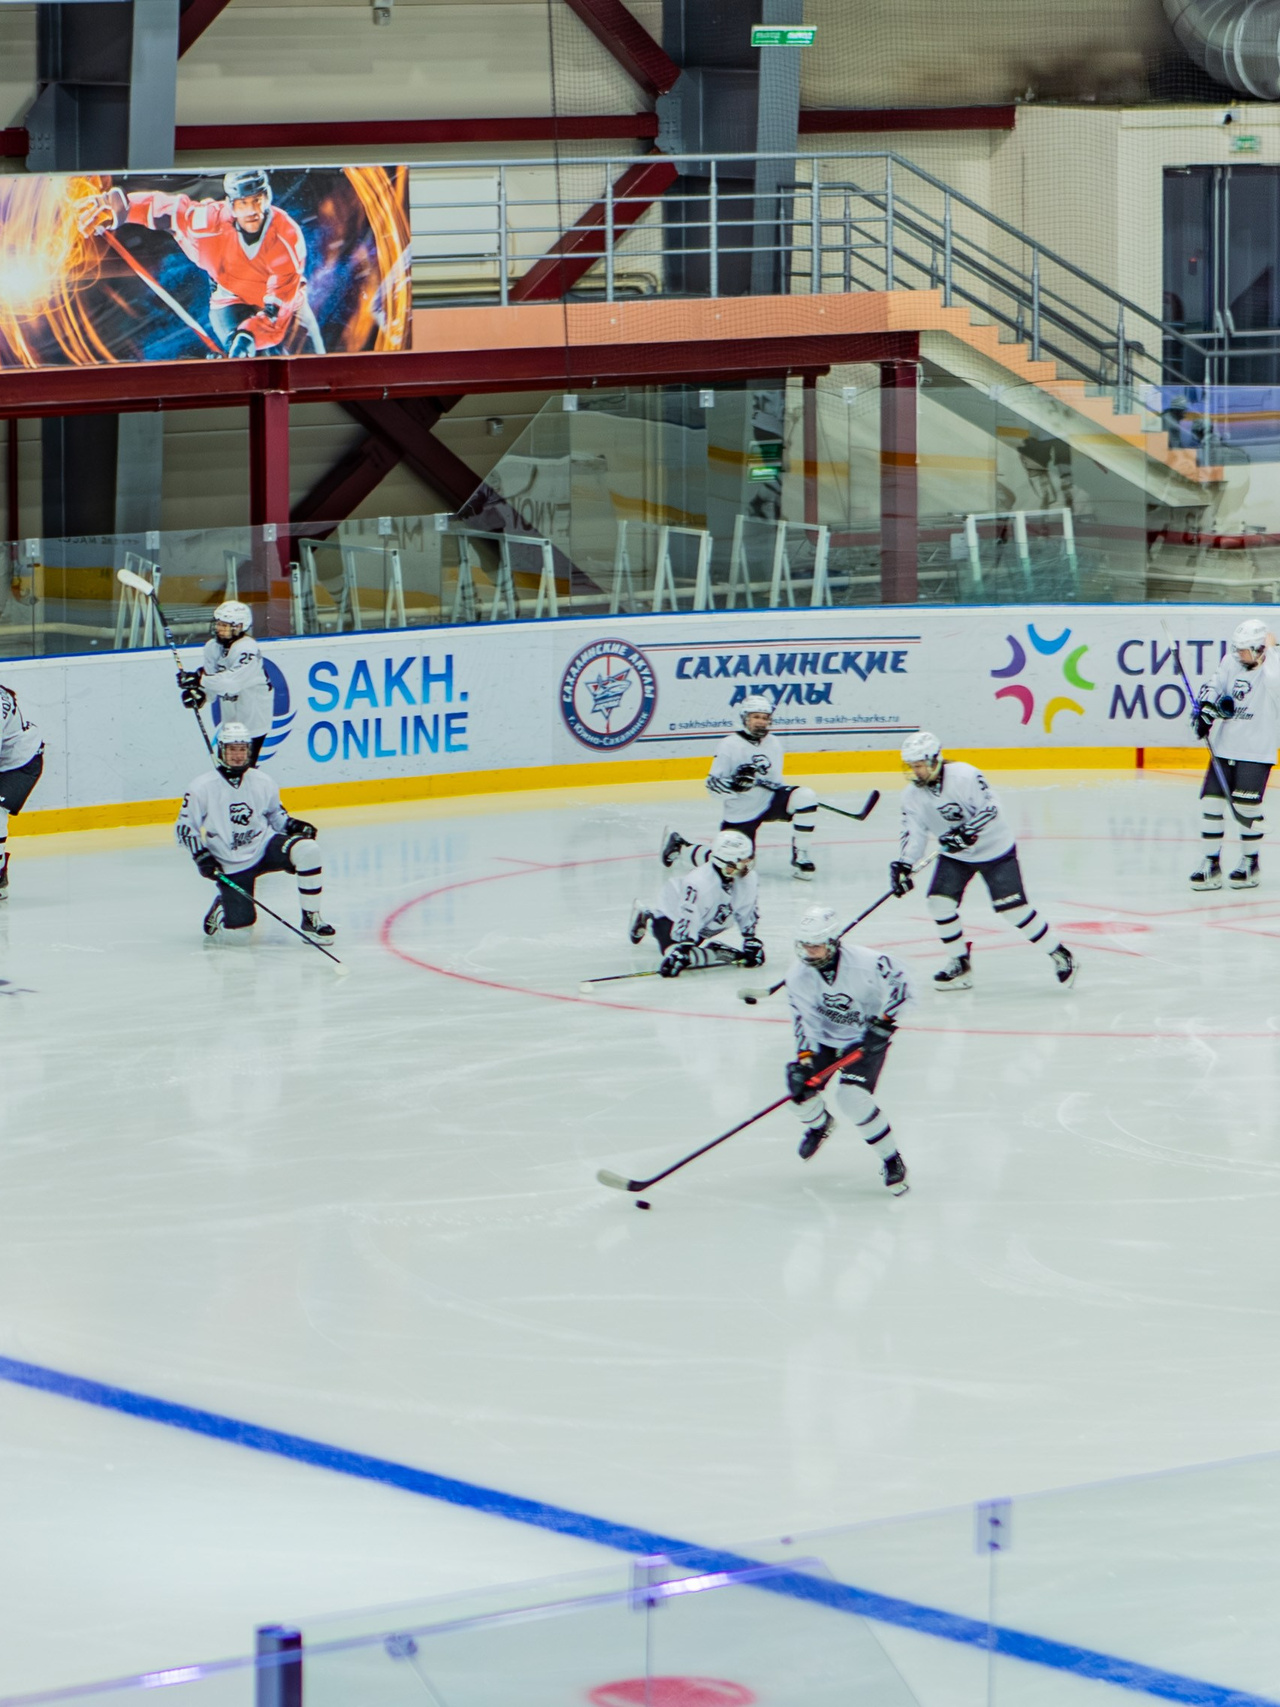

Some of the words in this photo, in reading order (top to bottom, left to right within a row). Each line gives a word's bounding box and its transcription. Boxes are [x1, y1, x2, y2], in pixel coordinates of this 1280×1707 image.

[562, 642, 629, 703] САХАЛИНСКИЕ
[675, 650, 909, 682] САХАЛИНСКИЕ
[1117, 639, 1227, 676] СИТ
[307, 654, 469, 713] SAKH.
[678, 718, 733, 730] sakhsharks
[772, 716, 807, 726] sharks
[823, 714, 900, 724] sakh-sharks.ru
[307, 711, 469, 763] ONLINE
